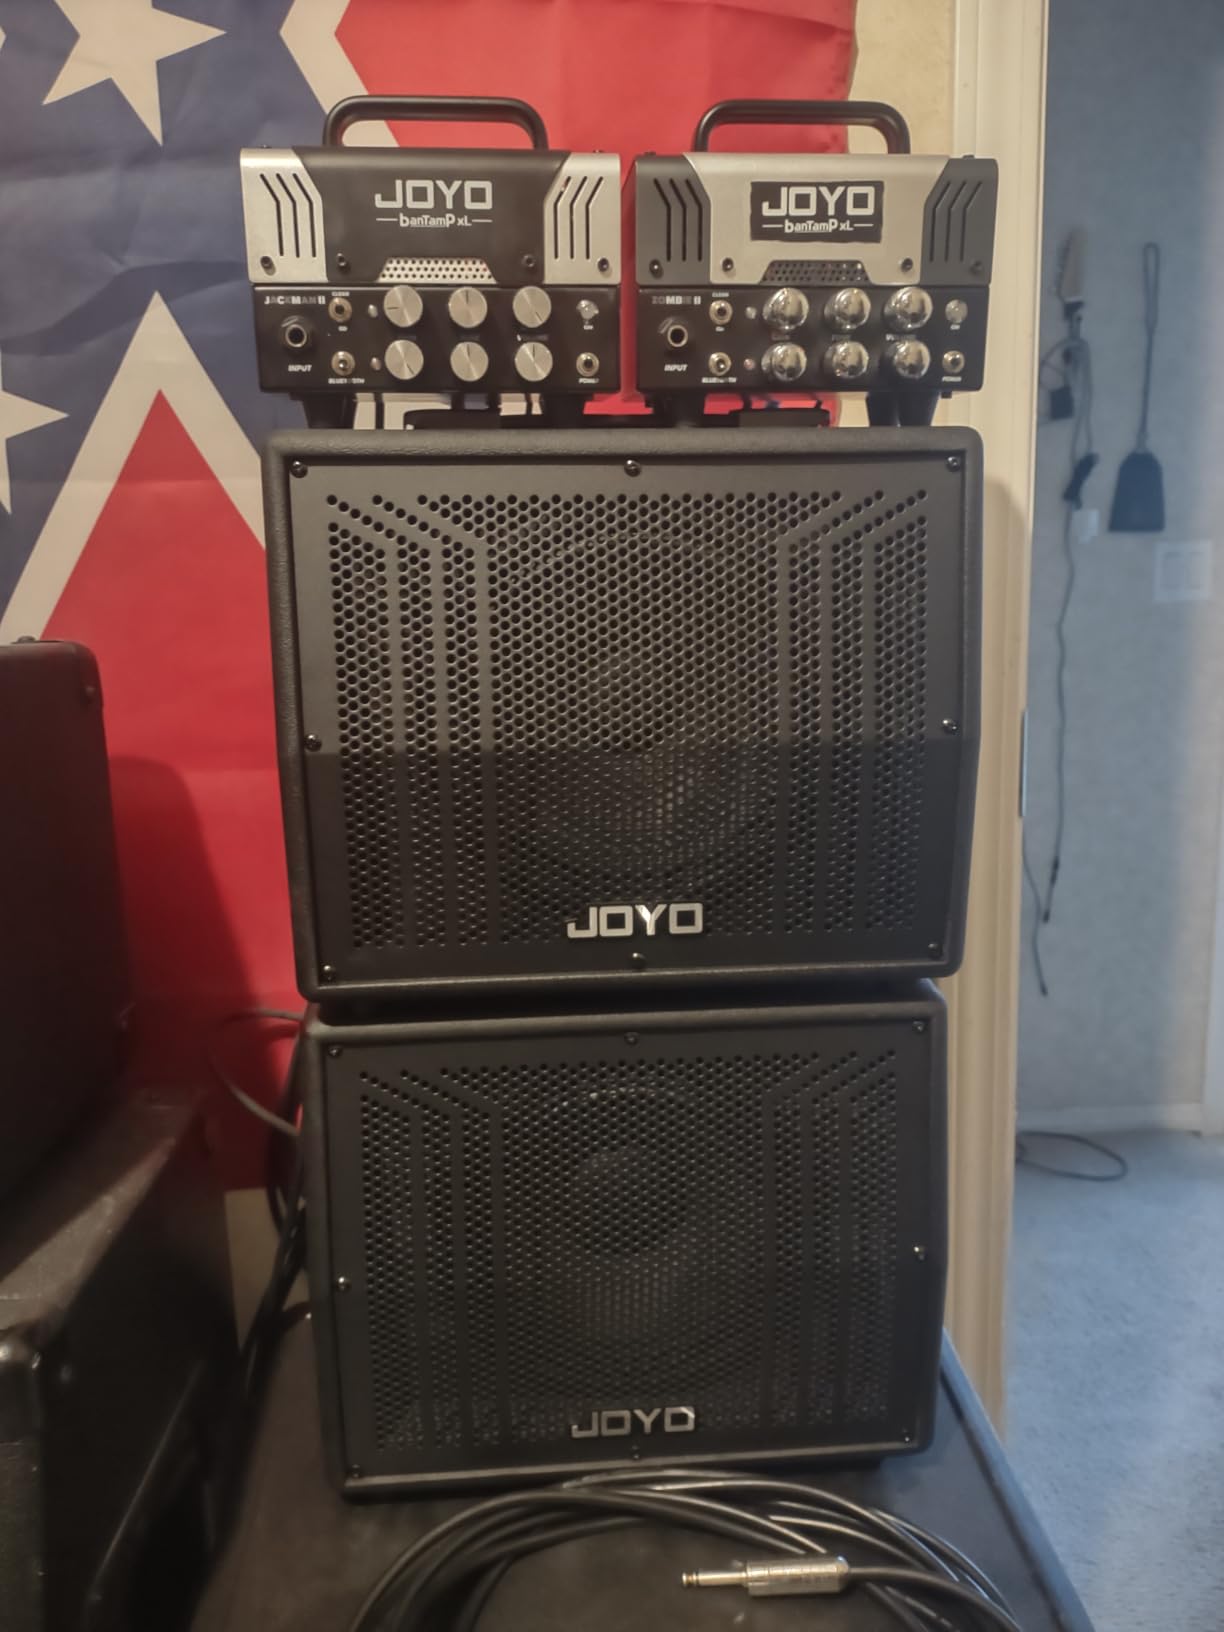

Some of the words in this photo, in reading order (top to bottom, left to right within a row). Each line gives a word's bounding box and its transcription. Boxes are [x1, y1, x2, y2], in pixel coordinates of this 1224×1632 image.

[375, 179, 492, 209] JOYO
[762, 186, 875, 216] JOYO
[264, 296, 316, 305] JACKMAN
[288, 364, 312, 372] INPUT
[567, 903, 703, 938] JOYO
[571, 1406, 695, 1438] JOYO
